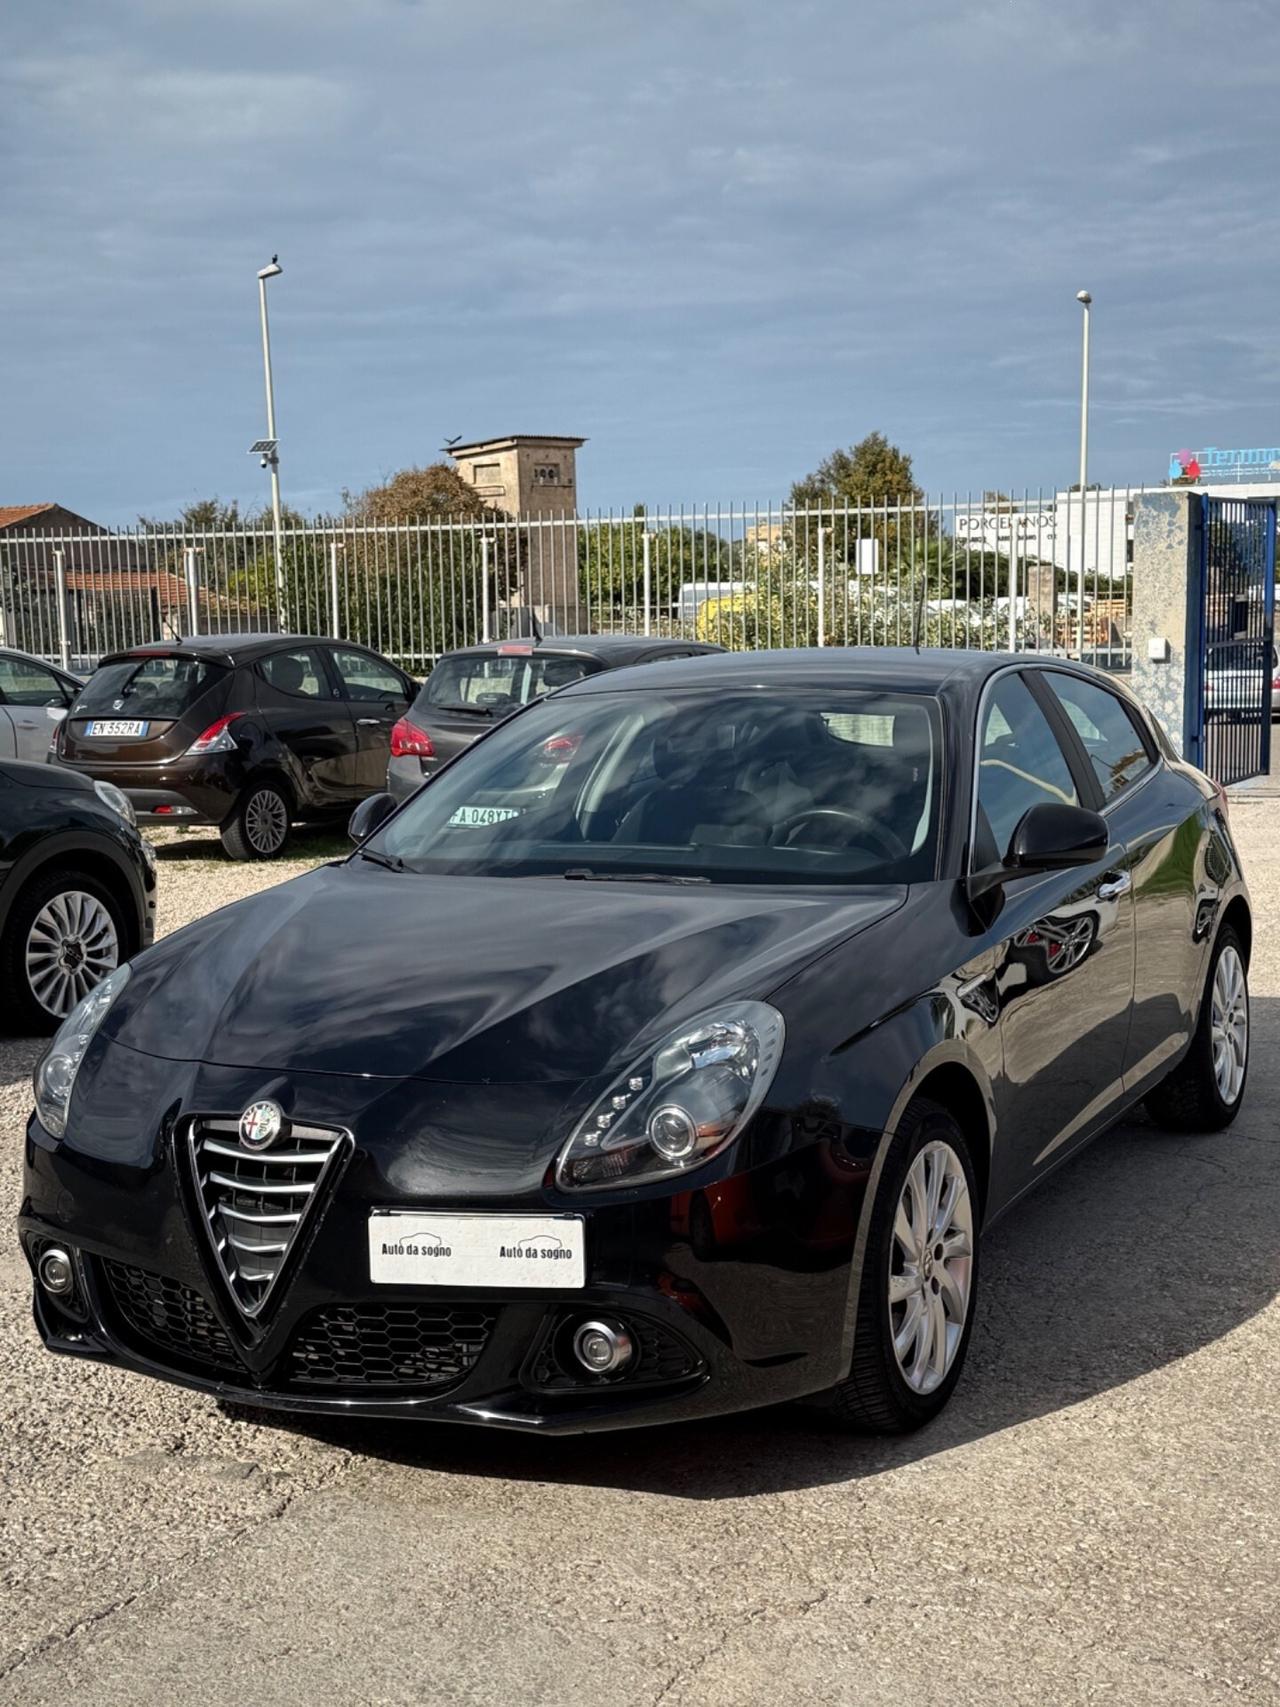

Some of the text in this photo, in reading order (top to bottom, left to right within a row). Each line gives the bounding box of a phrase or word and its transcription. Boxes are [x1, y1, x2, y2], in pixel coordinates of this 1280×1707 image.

[471, 809, 511, 824] 048YT
[382, 1243, 452, 1257] Auto da sogno
[500, 1246, 572, 1260] Auto da sogno
